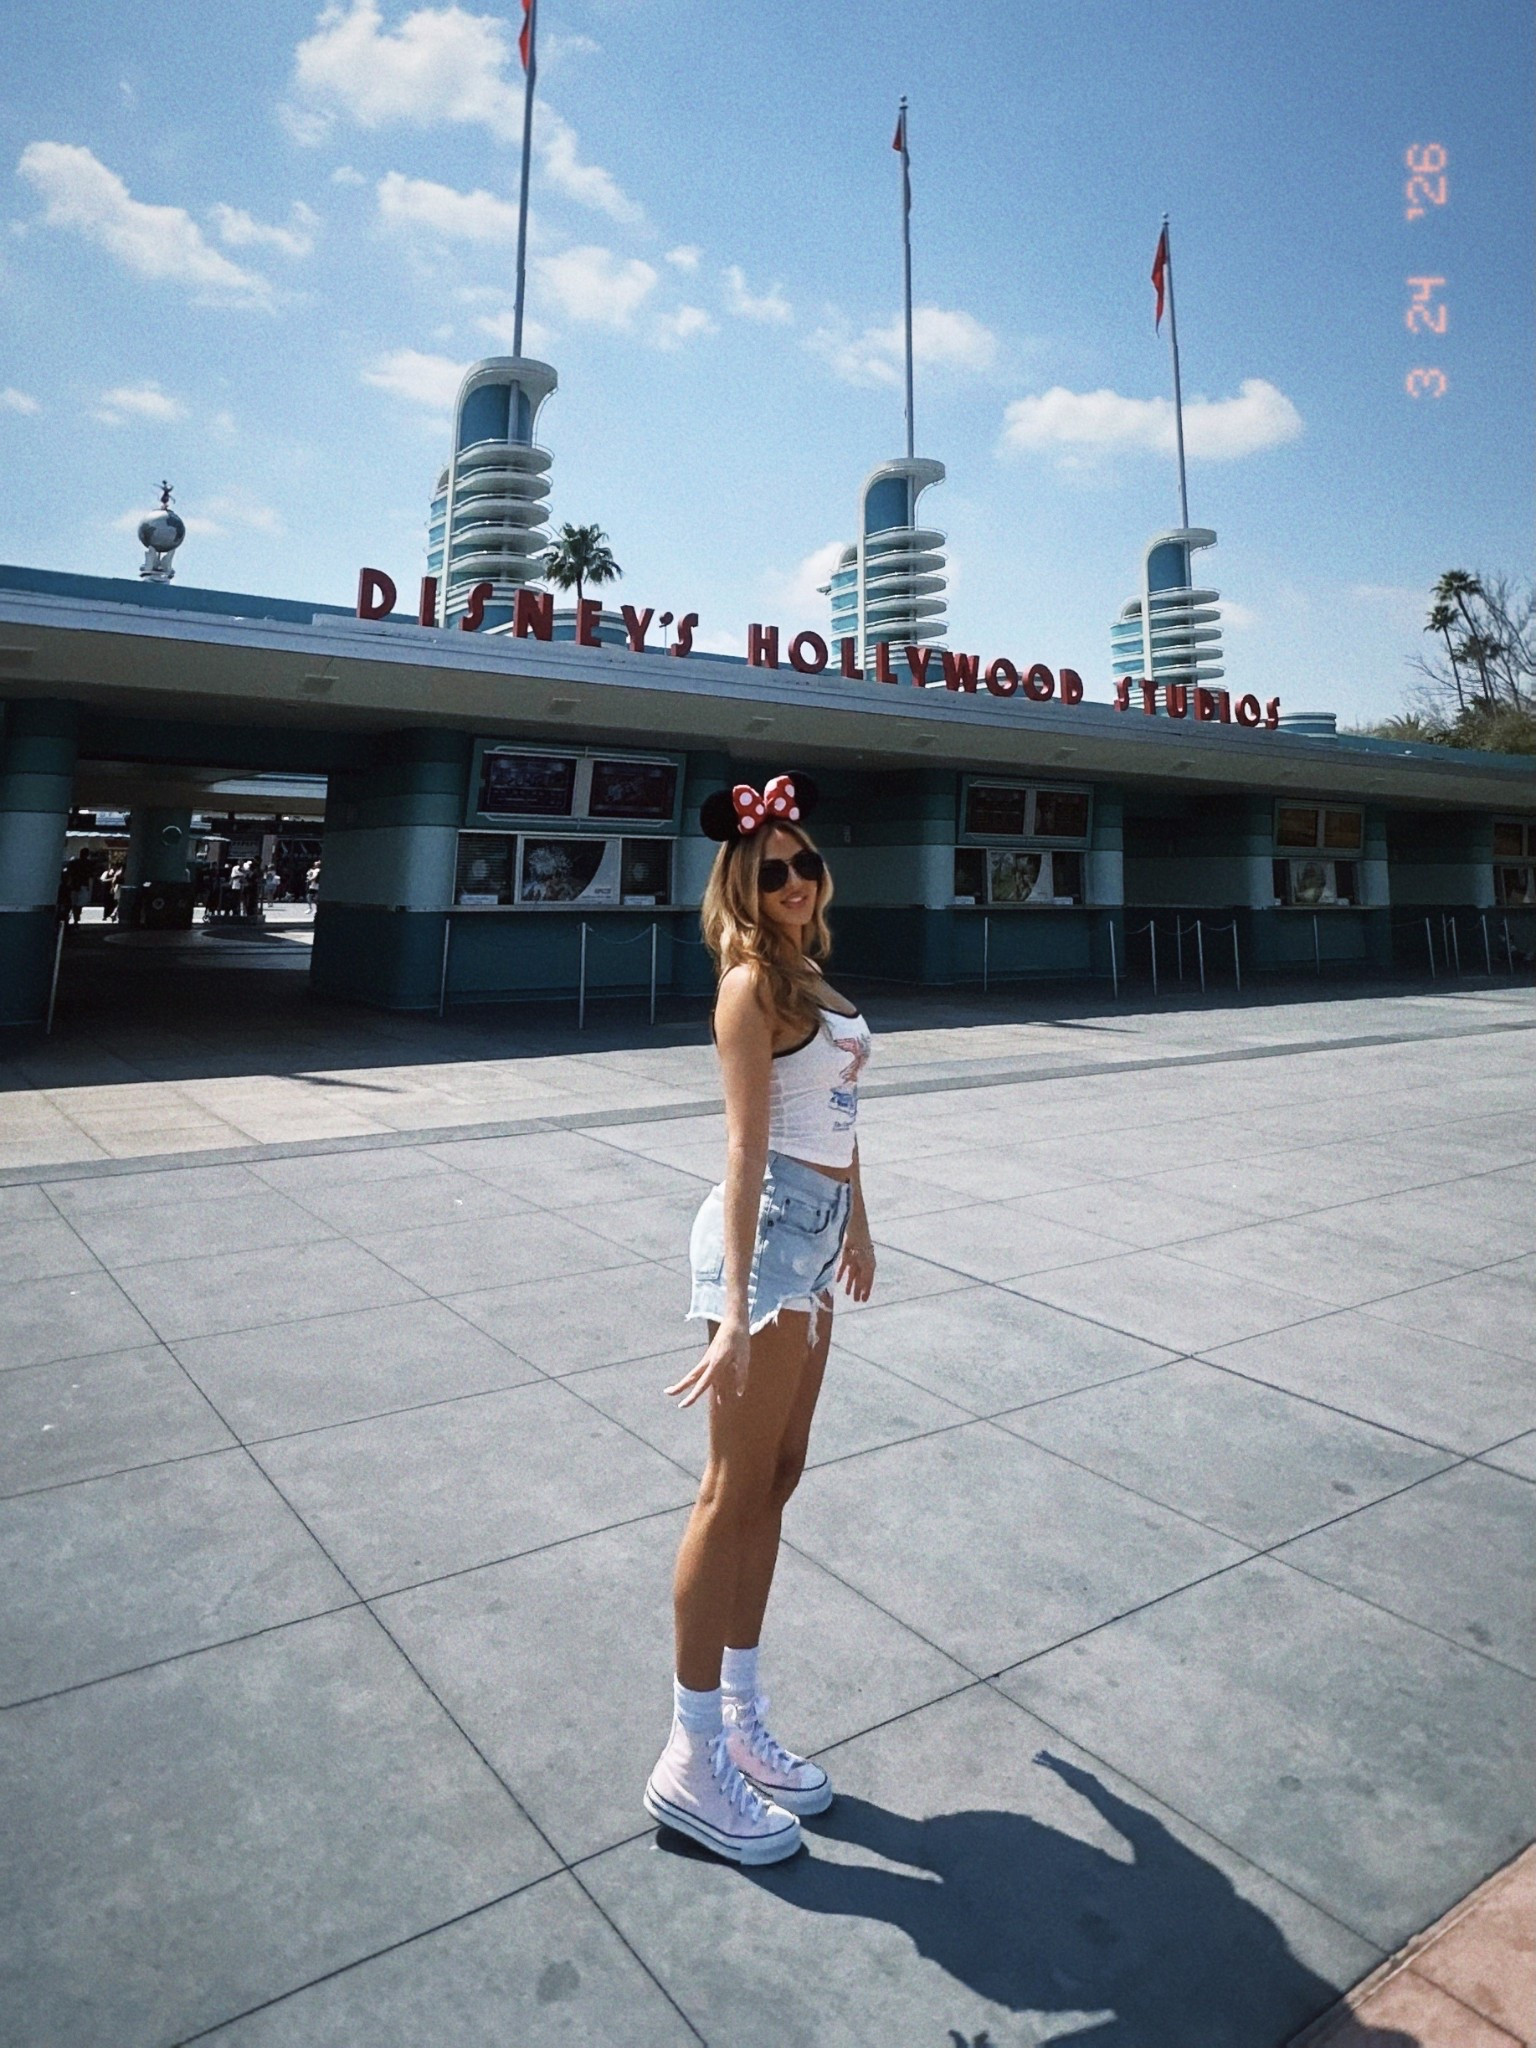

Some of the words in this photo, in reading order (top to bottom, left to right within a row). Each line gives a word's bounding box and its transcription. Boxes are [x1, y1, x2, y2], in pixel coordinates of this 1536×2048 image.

[356, 567, 699, 657] DISNEY'S
[747, 623, 1084, 705] HOLLYWOOD
[1113, 676, 1281, 730] STUDIOS
